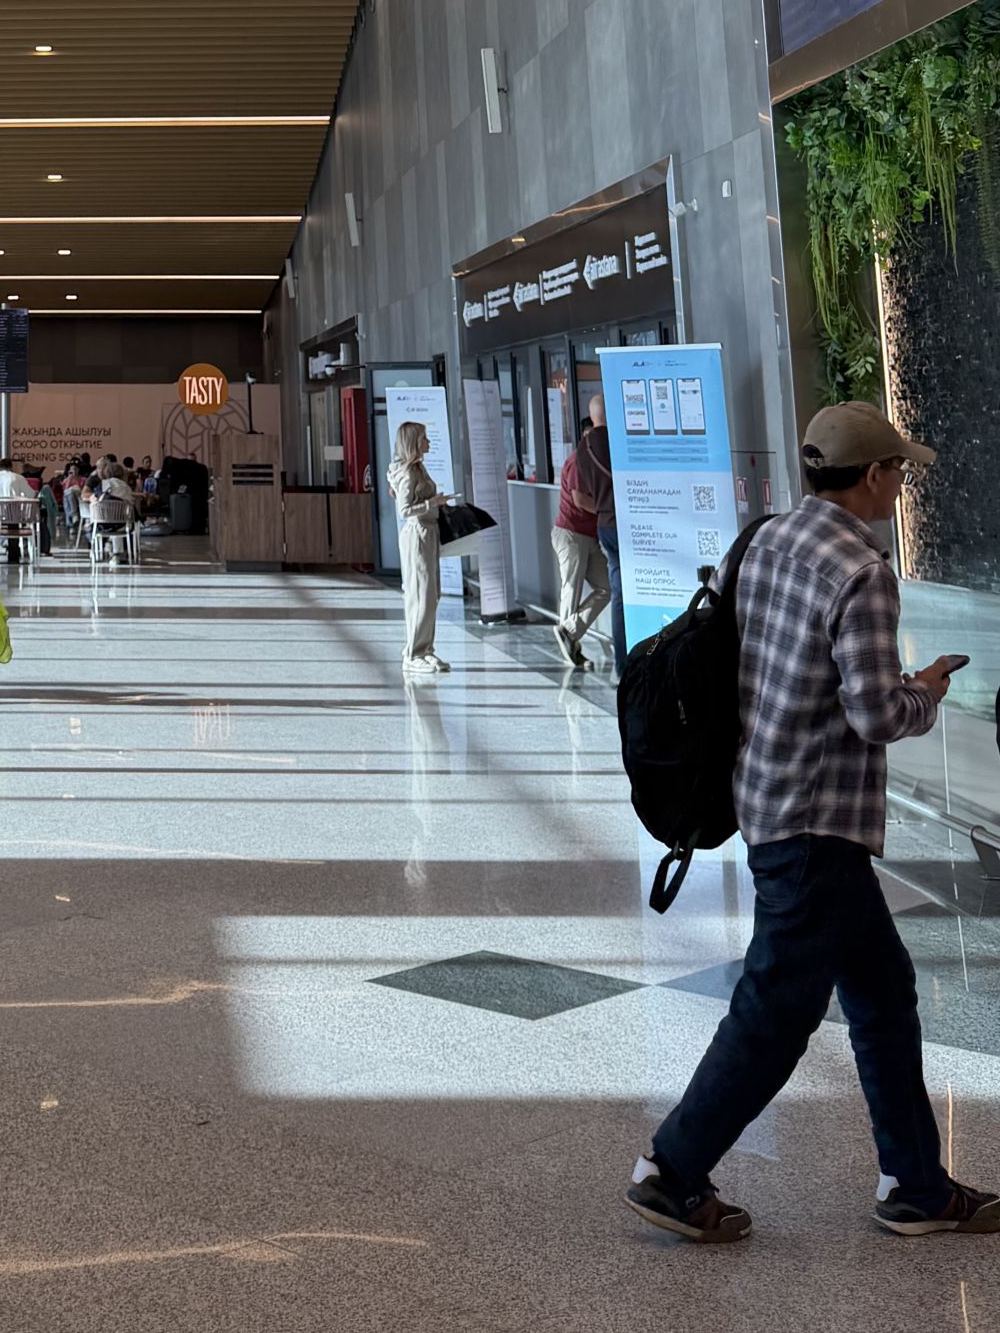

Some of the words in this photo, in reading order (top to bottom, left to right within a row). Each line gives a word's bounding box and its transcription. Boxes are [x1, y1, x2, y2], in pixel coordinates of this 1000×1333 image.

[183, 376, 223, 405] TASTY
[65, 427, 112, 436] АШЫЛУЫ
[12, 440, 48, 449] СКОРО
[50, 440, 103, 449] ОТКРЫТИЕ
[12, 452, 57, 462] OPENING
[634, 568, 670, 576] ПРОЙДИТЕ
